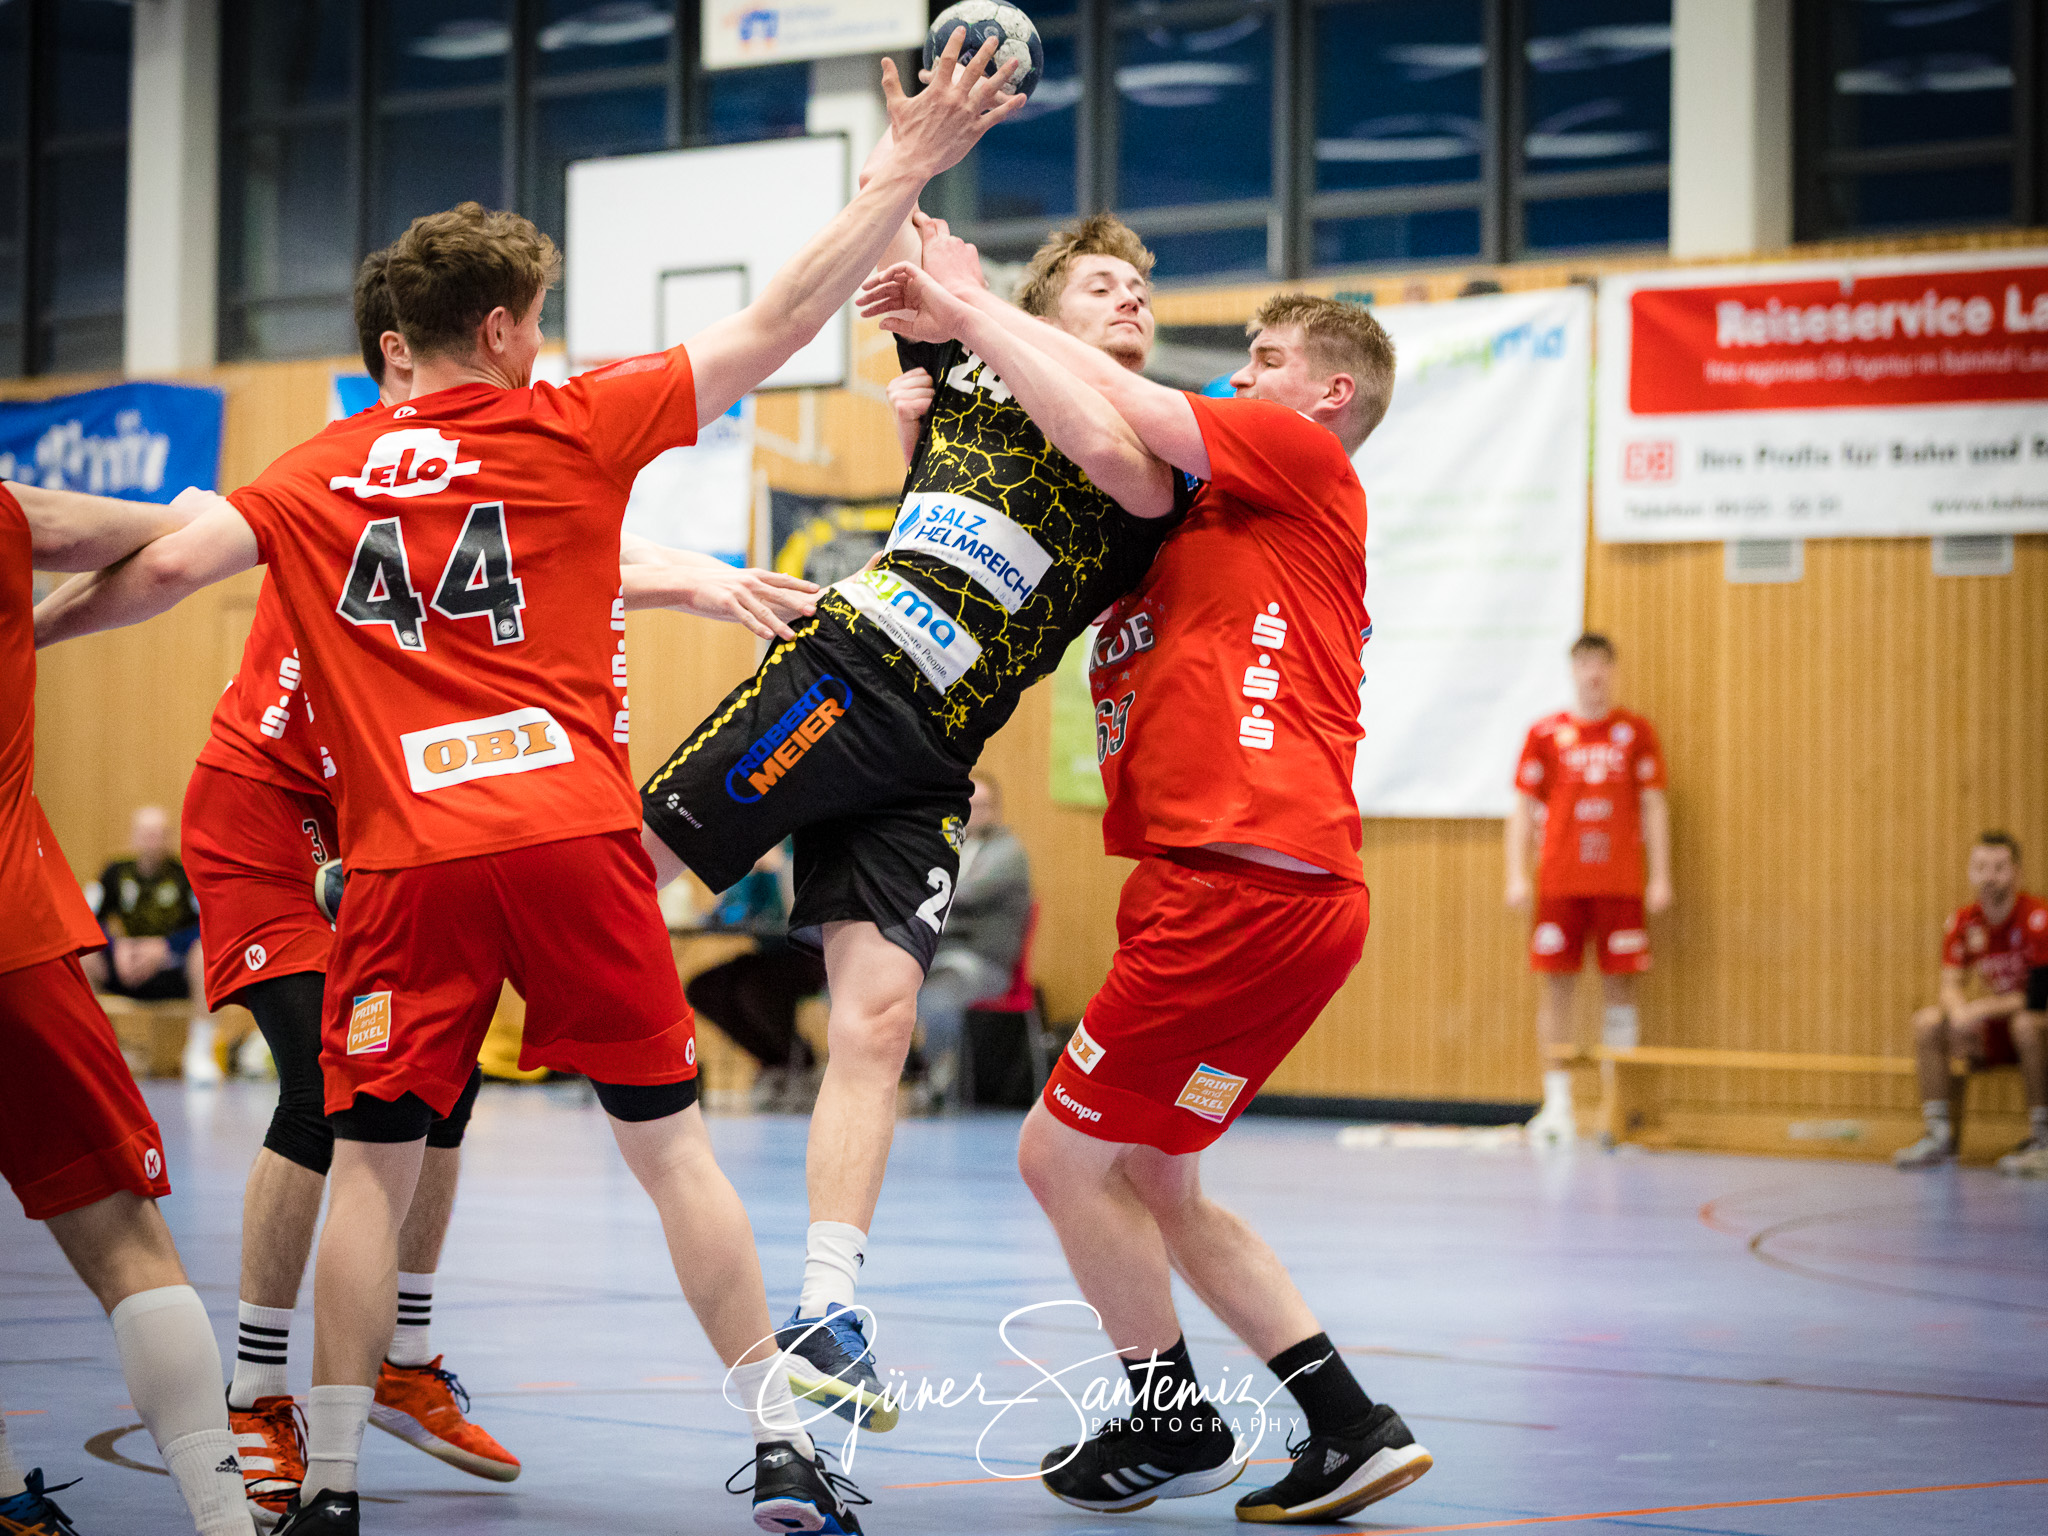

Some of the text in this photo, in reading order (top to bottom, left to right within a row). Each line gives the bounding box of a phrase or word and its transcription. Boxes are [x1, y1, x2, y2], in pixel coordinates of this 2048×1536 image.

[1715, 289, 1995, 348] Reiseservice
[926, 504, 987, 536] SALZ
[335, 500, 526, 652] 44
[914, 525, 1033, 601] HELMREICH
[423, 720, 556, 774] OBI
[734, 682, 827, 780] ROBERT
[748, 697, 846, 796] MEIER
[915, 866, 956, 935] 2
[355, 999, 385, 1022] PRINT
[360, 1013, 377, 1029] and
[352, 1025, 385, 1046] PIXEL
[1070, 1032, 1097, 1065] BI
[1184, 1092, 1225, 1110] PIXEL
[1196, 1076, 1239, 1092] PRINT
[1201, 1088, 1223, 1099] and
[1052, 1083, 1103, 1123] Kempa
